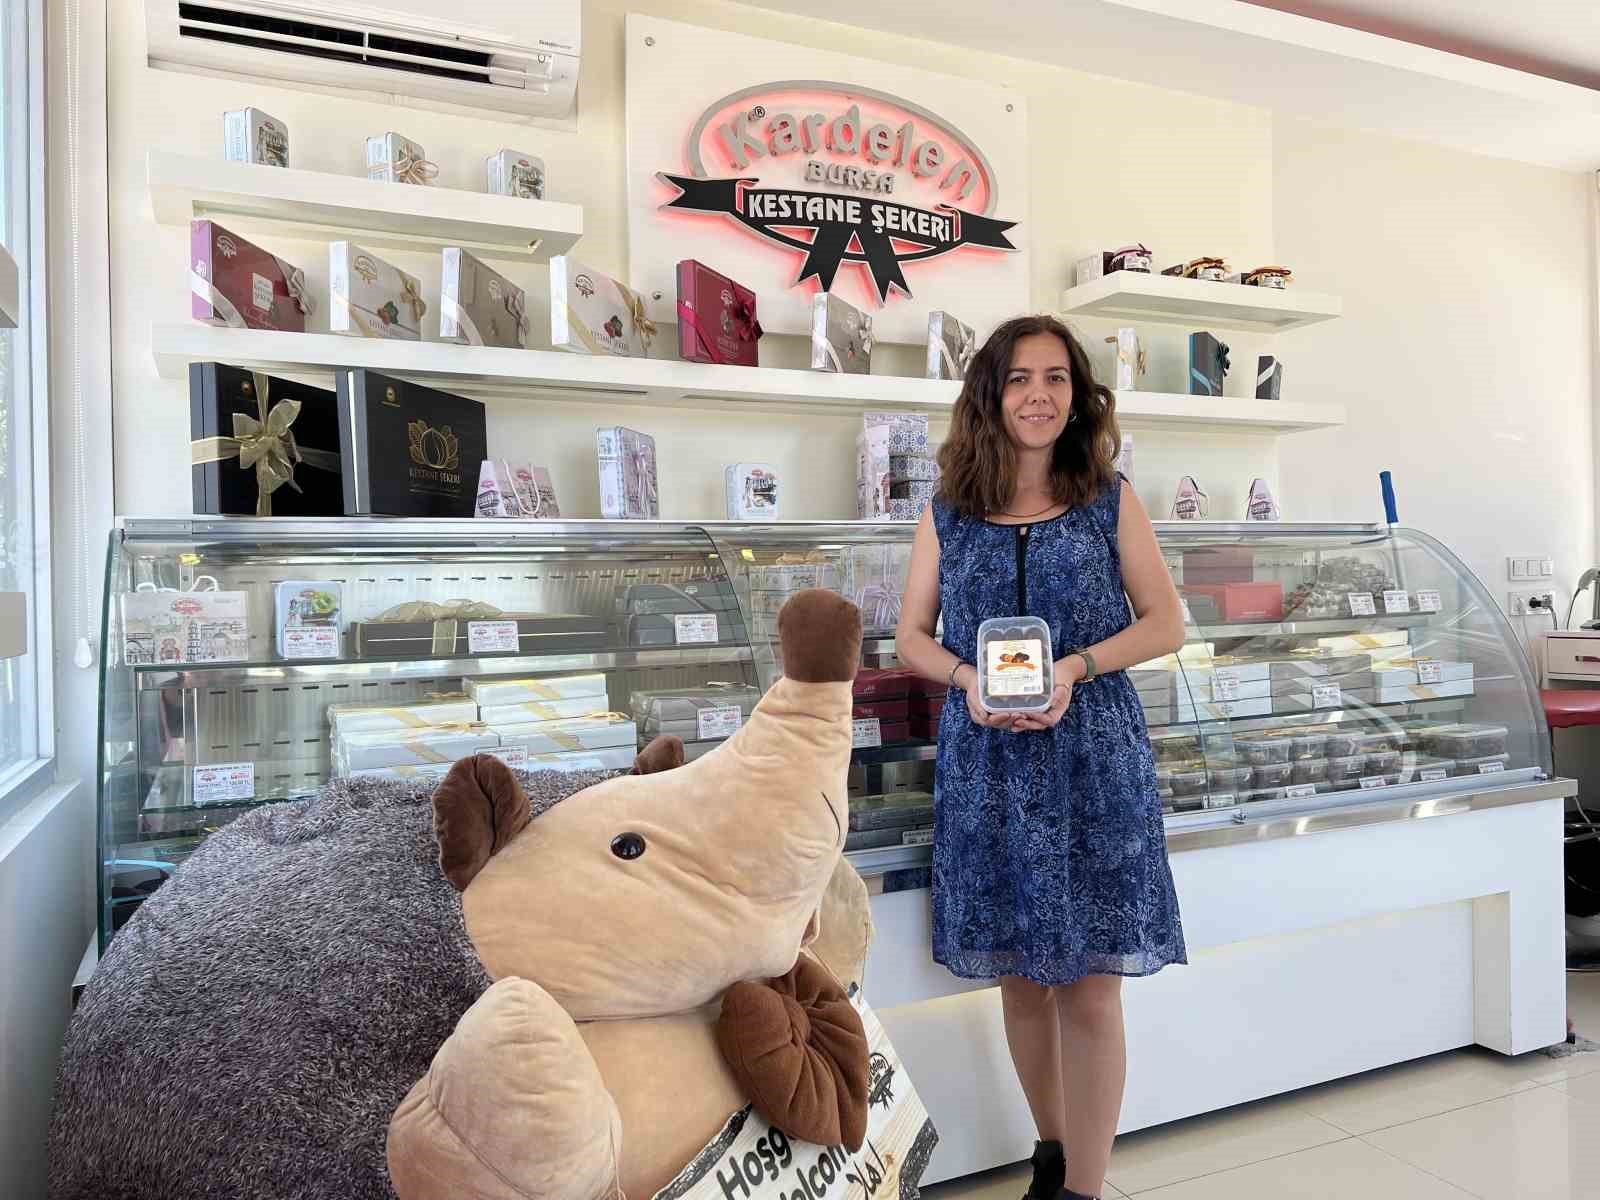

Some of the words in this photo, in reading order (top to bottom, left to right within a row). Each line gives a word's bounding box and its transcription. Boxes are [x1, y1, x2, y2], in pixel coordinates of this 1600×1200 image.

[720, 105, 979, 201] Kardelen
[804, 160, 895, 194] BURSA
[749, 194, 862, 224] KESTANE
[716, 1126, 793, 1200] Hoşg
